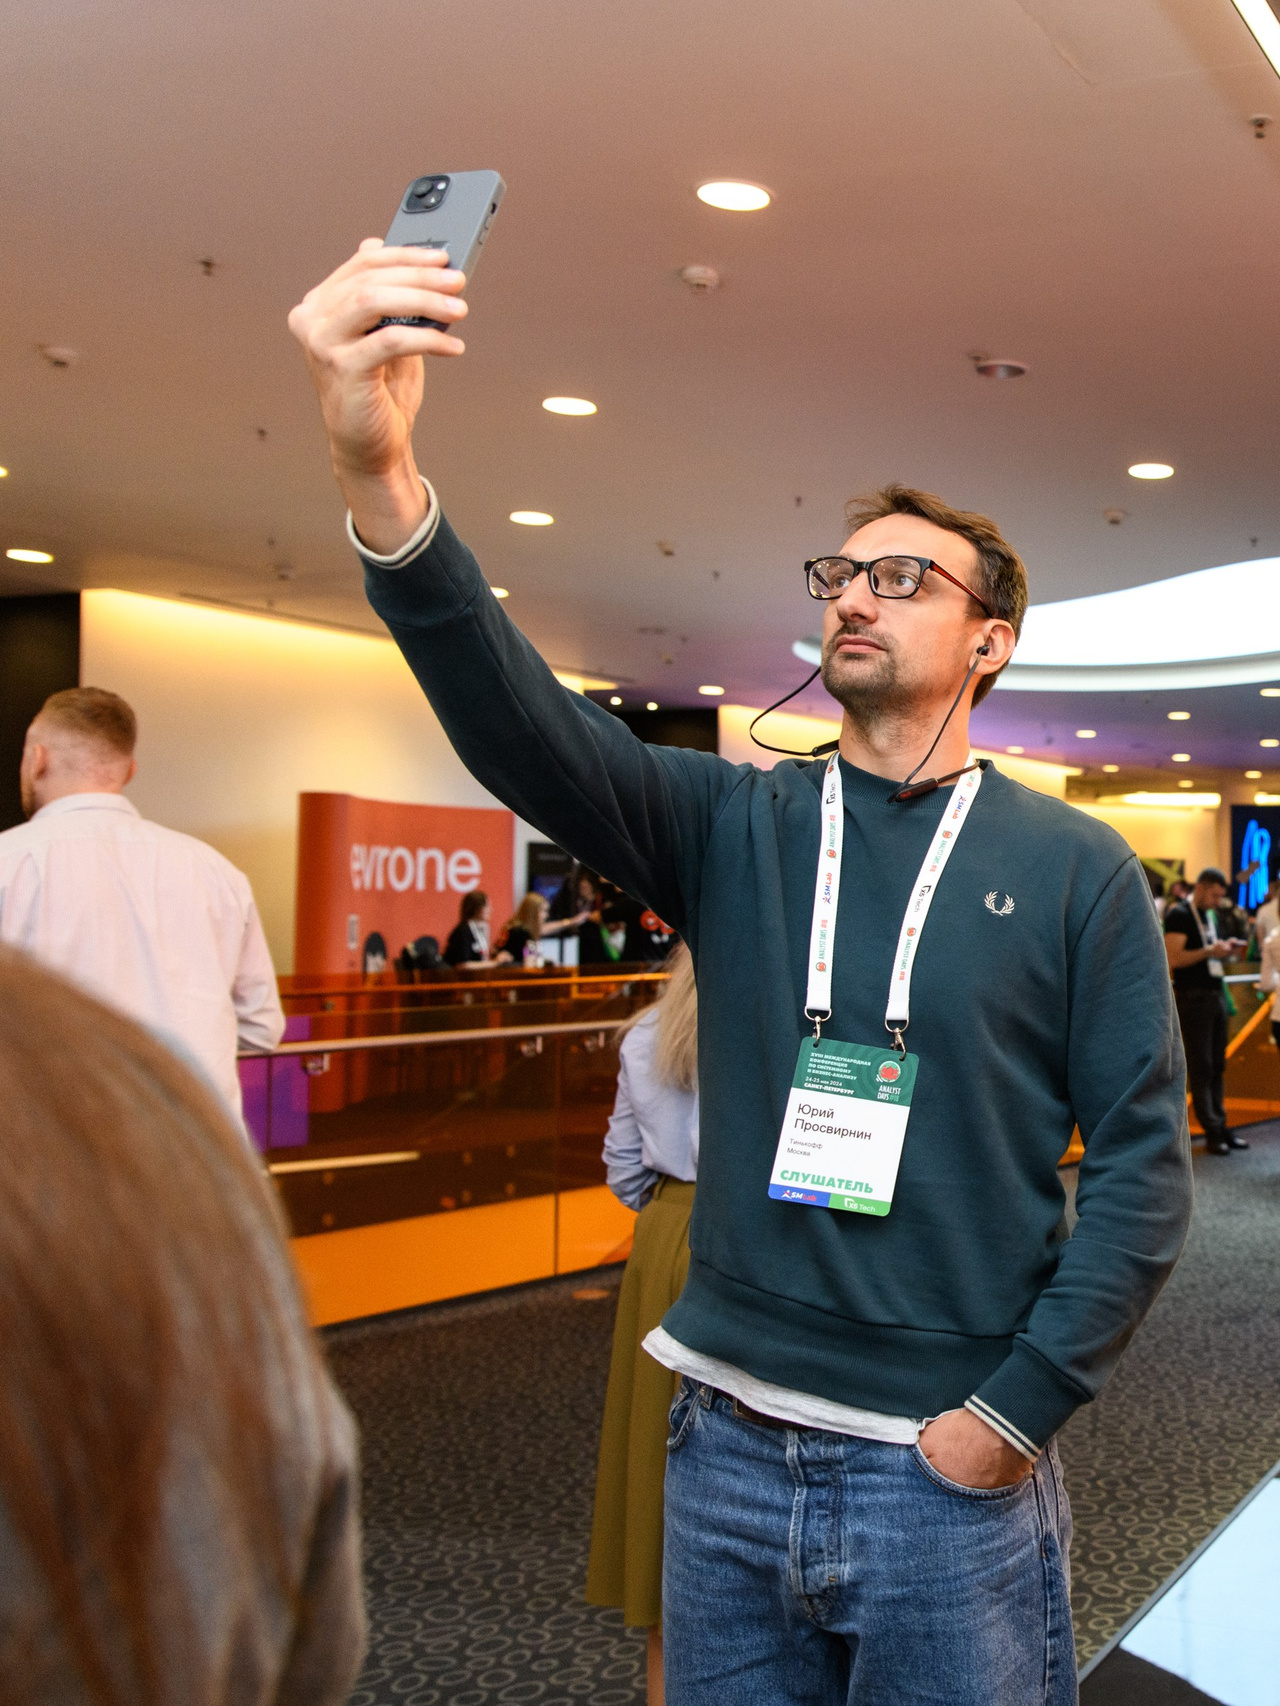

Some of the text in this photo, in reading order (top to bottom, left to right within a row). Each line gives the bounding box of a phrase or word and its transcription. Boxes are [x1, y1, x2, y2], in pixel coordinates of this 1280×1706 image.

[349, 843, 483, 893] evrone
[878, 1084, 901, 1095] ANALYST
[797, 1103, 835, 1120] Юрий
[794, 1118, 872, 1140] Просвирнин
[787, 1147, 811, 1157] Москва
[789, 1138, 823, 1150] Тинькофф
[780, 1169, 874, 1194] СЛУШАТЕЛЬ
